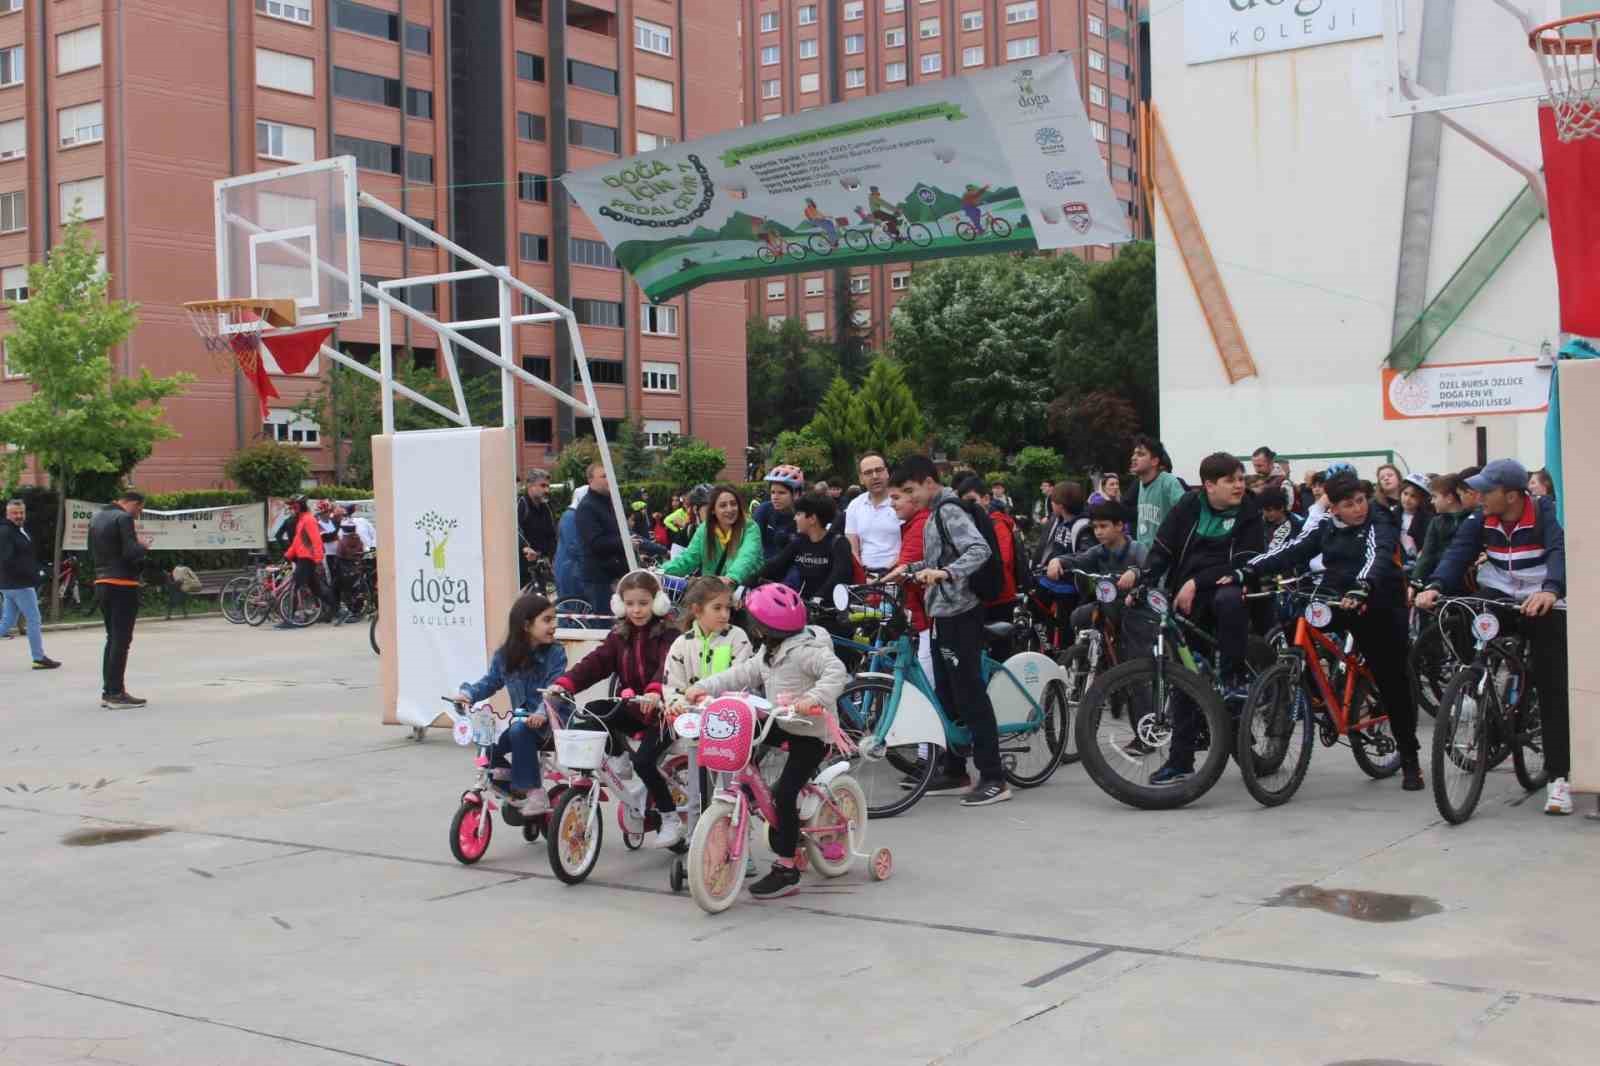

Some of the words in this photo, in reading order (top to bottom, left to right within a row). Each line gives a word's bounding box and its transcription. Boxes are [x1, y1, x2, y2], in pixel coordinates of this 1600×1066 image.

[1229, 9, 1357, 46] KOLEJİ
[1462, 377, 1489, 388] BURSA
[1466, 390, 1481, 399] FEN
[1483, 389, 1493, 398] VE
[411, 568, 470, 613] doğa
